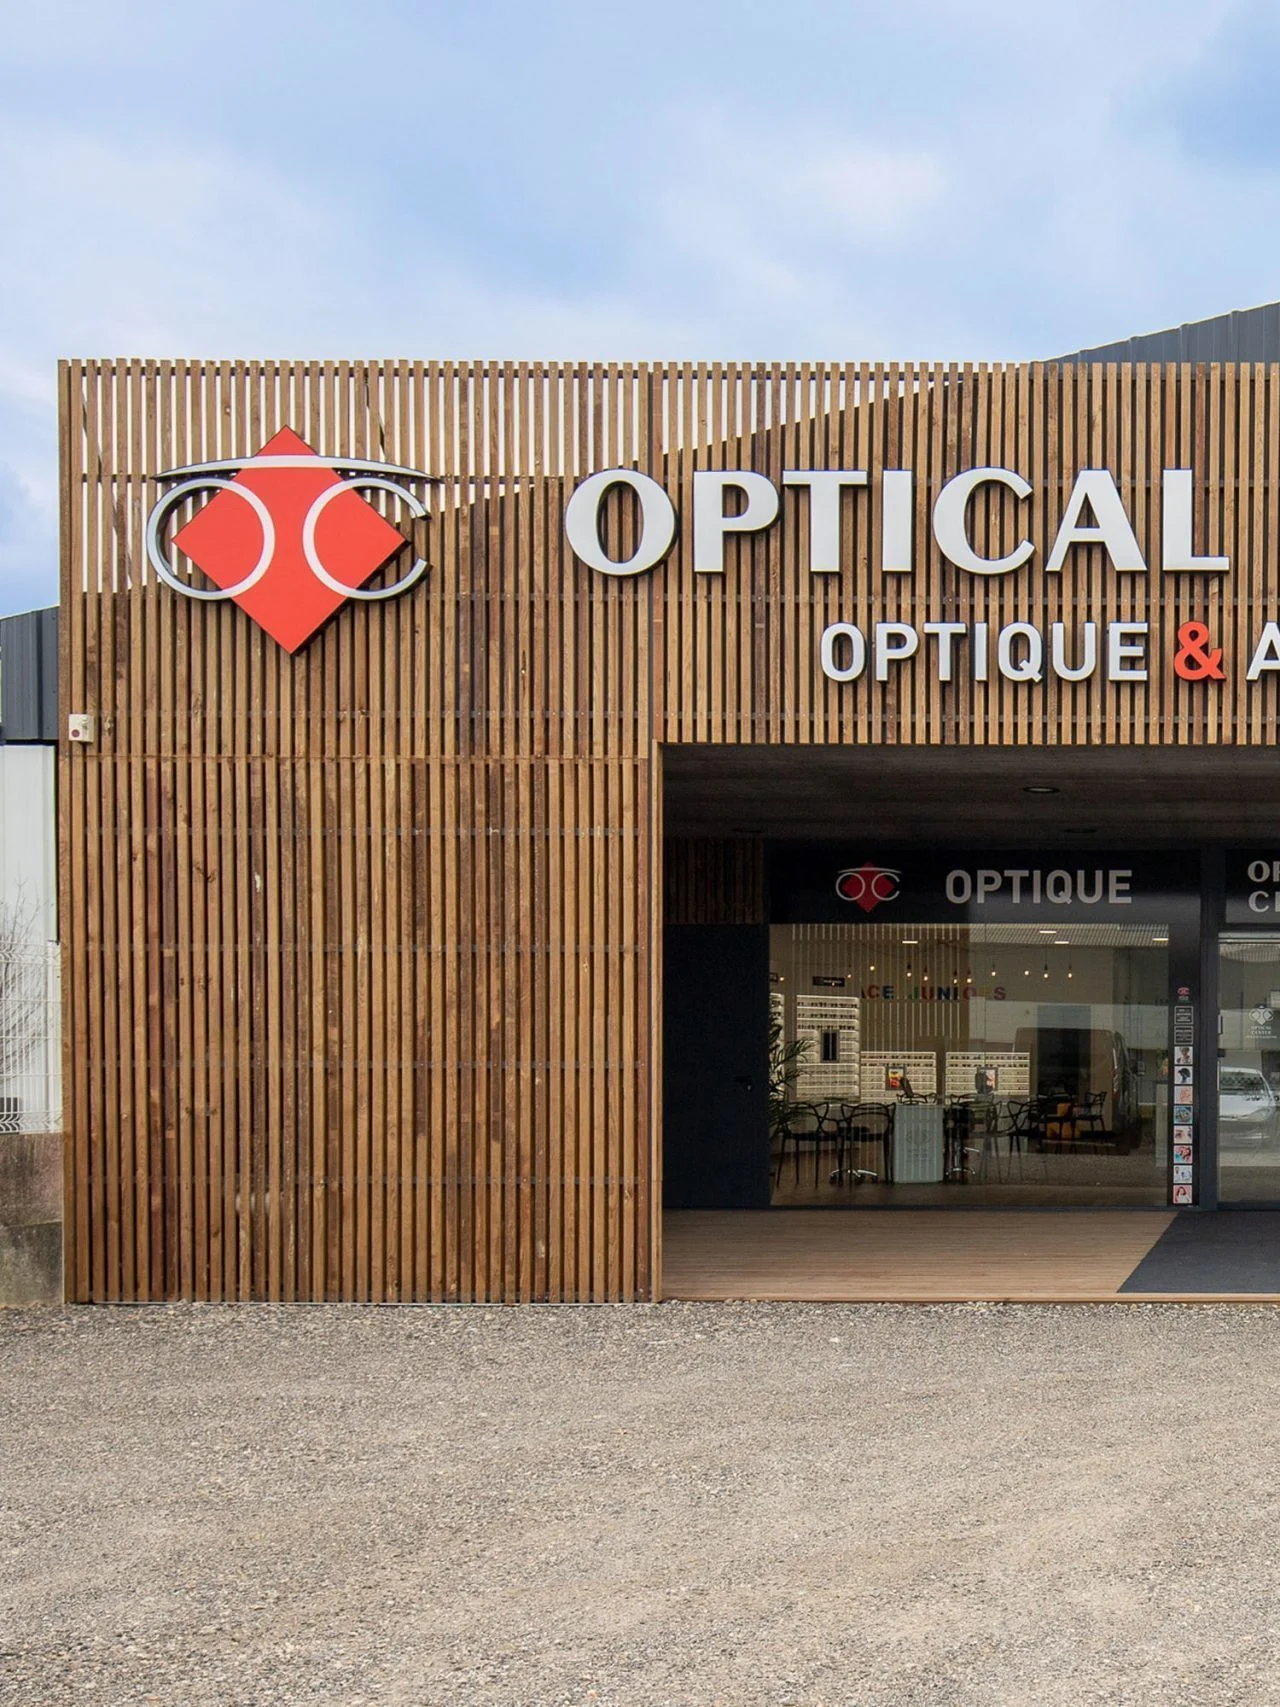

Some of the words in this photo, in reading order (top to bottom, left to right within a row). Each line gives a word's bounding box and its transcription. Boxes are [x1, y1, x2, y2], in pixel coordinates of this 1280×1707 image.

[564, 467, 1230, 576] OPTICAL
[820, 621, 1148, 683] OPTIQUE
[1173, 620, 1226, 681] &
[945, 869, 1133, 904] OPTIQUE
